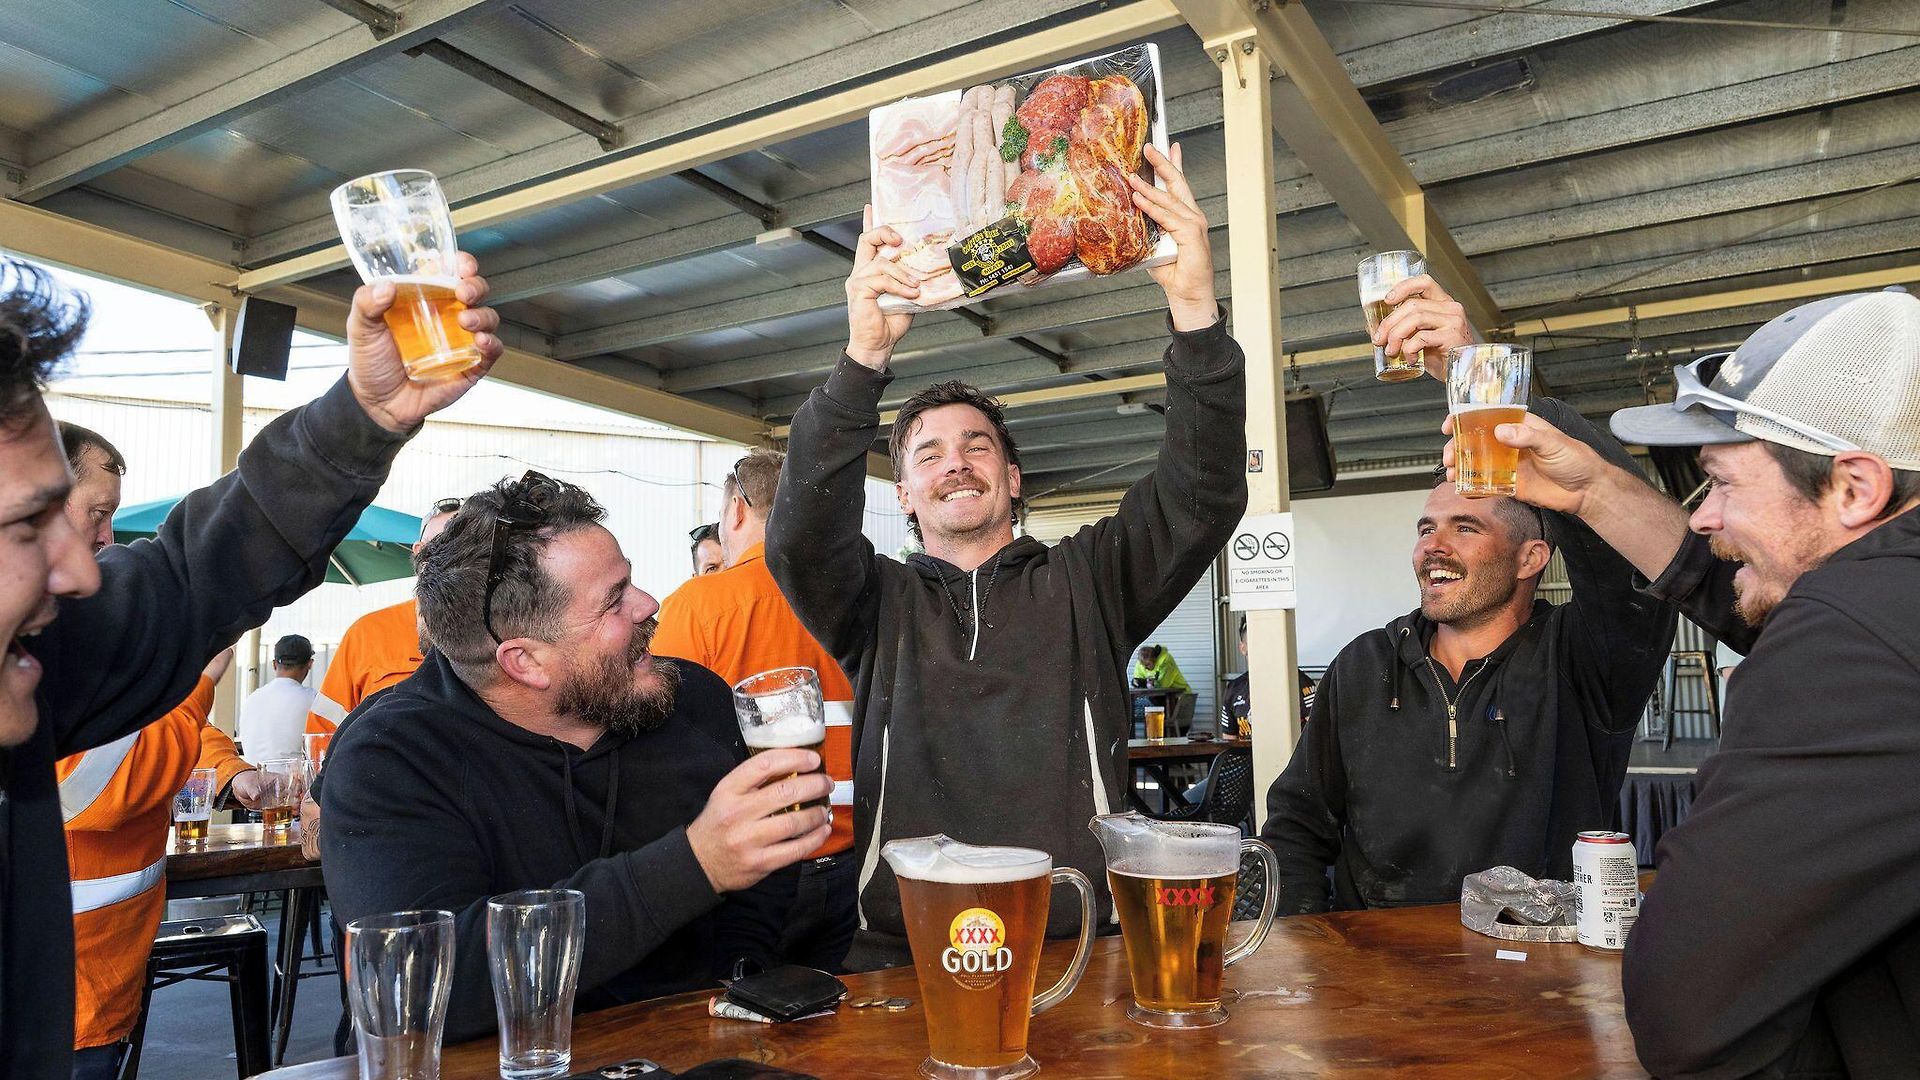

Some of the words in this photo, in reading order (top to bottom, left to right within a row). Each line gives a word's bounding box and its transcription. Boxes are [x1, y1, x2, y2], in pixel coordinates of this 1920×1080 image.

[1156, 886, 1216, 906] XXXX
[953, 927, 1002, 944] XXXX
[941, 946, 1013, 973] GOLD
